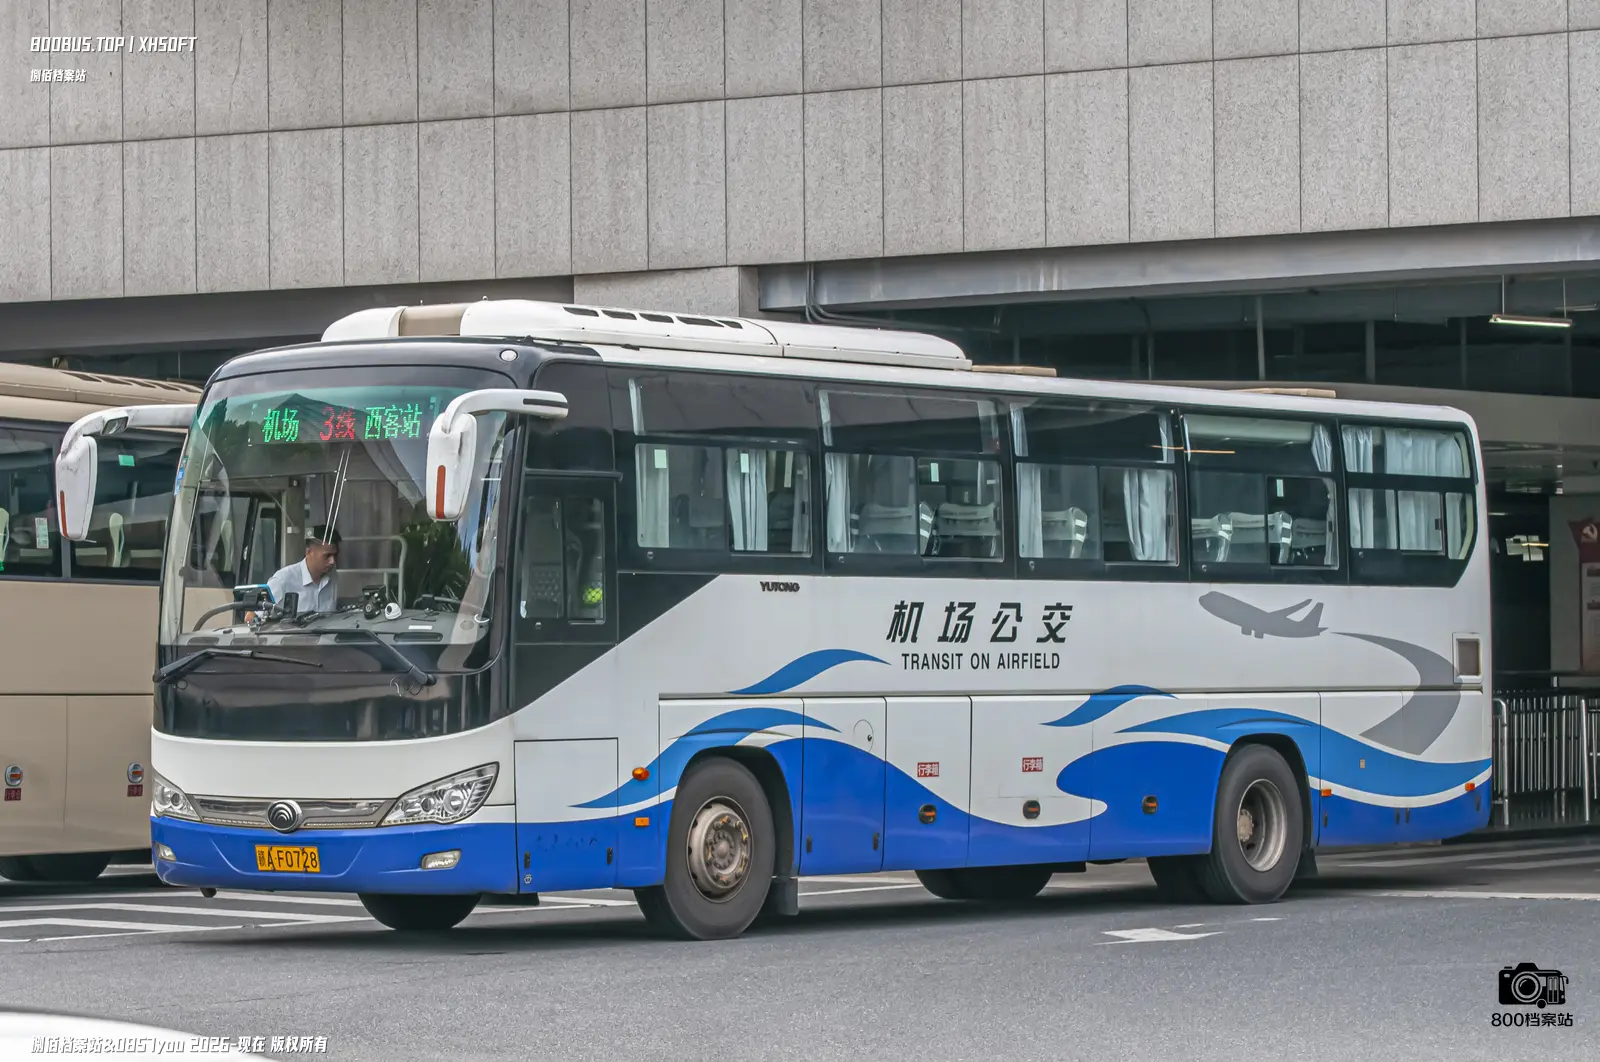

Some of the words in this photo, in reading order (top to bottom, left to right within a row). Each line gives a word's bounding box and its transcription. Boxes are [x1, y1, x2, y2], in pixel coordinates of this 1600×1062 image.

[262, 408, 299, 443] 机场
[319, 406, 357, 441] 3线
[364, 403, 423, 440] 西客站
[759, 580, 800, 592] YUTONG
[886, 600, 1073, 643] 机场公交
[901, 653, 963, 670] TRANSIT
[970, 653, 990, 670] ON
[997, 653, 1060, 669] AIRFIELD
